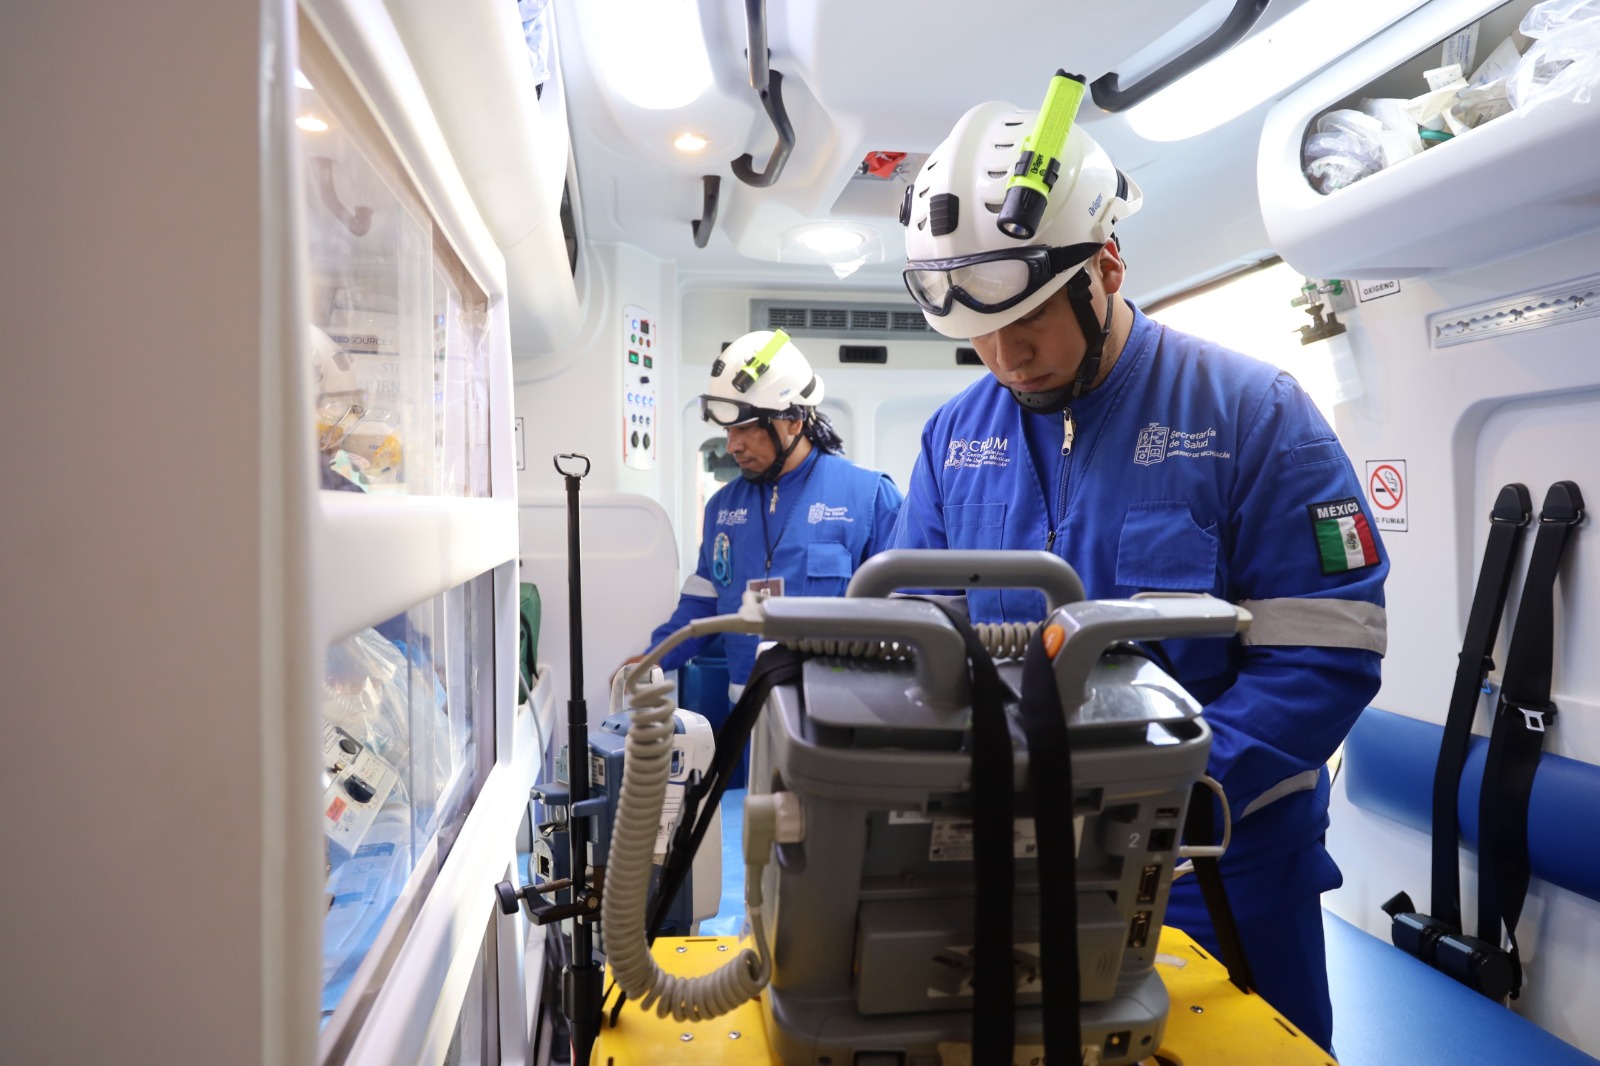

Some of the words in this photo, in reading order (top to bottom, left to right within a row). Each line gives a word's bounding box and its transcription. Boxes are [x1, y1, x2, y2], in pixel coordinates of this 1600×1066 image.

[1170, 428, 1216, 439] Secretaría
[1169, 440, 1180, 448] de
[1184, 439, 1208, 448] Salud
[1317, 502, 1359, 518] MÉXICO
[1129, 834, 1140, 848] 2
